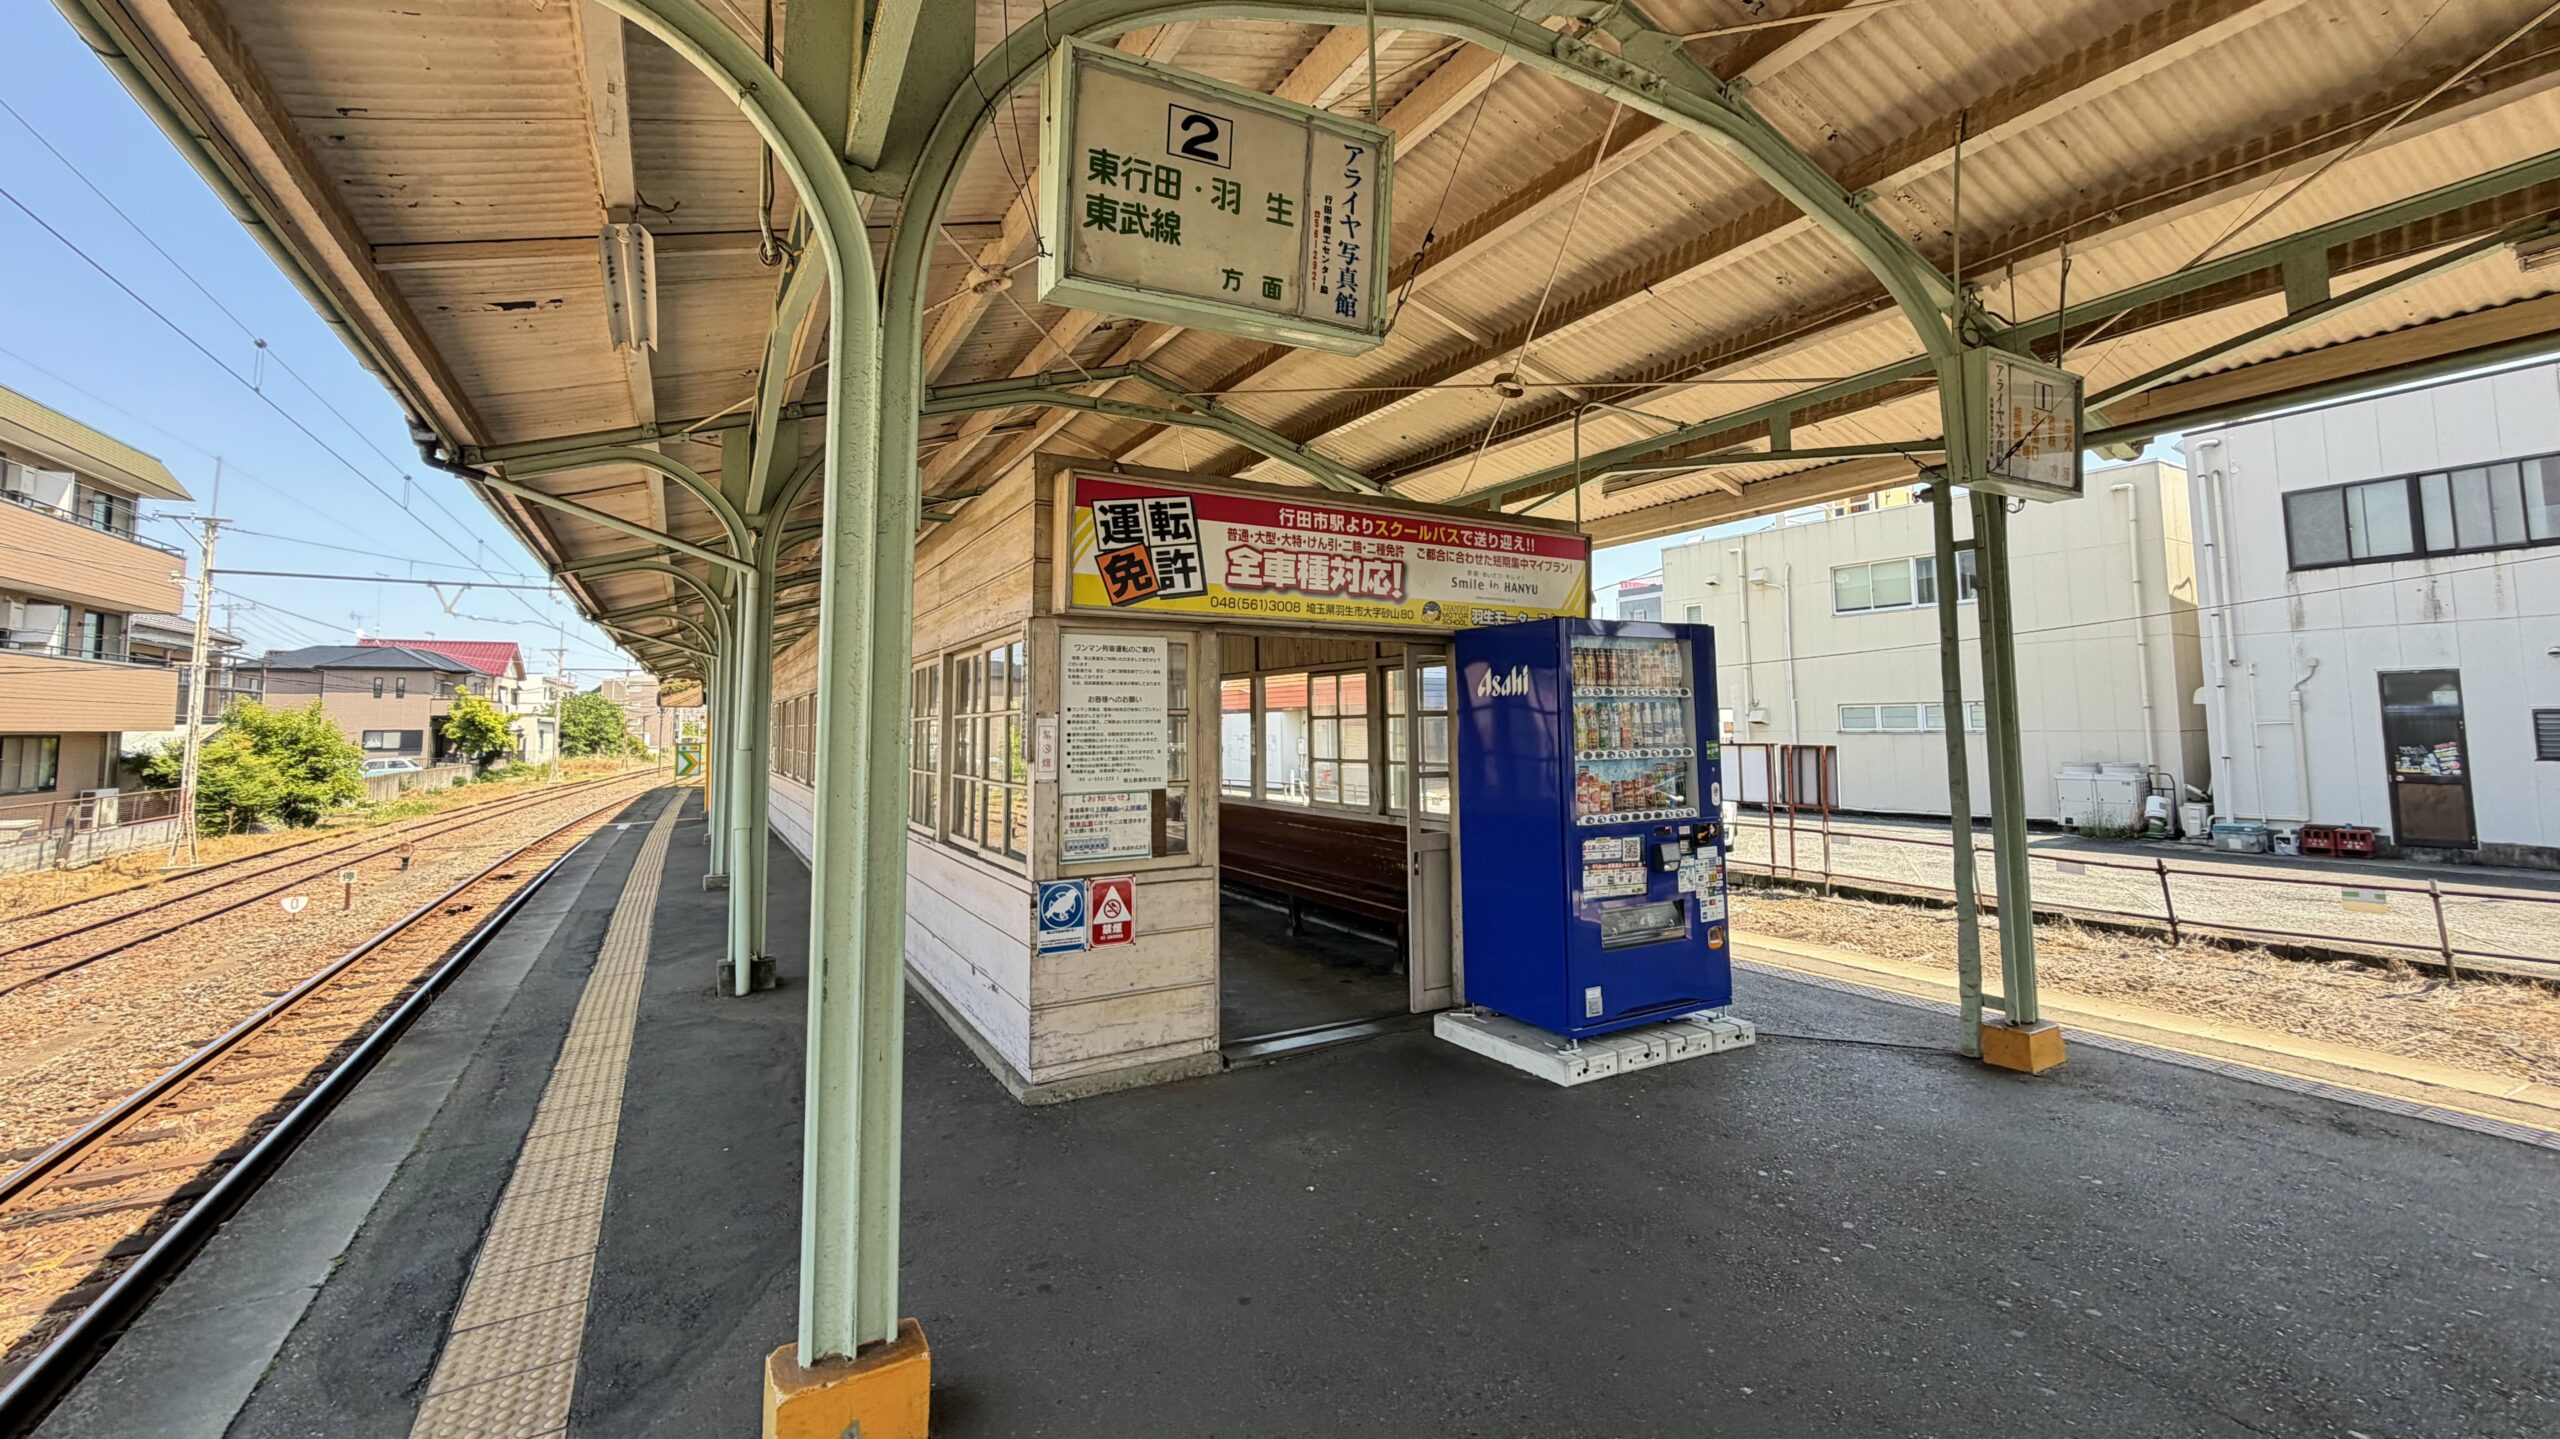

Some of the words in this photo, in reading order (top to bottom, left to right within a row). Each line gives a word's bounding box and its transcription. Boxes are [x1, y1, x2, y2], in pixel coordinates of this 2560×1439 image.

[1180, 114, 1219, 162] 2
[1082, 193, 1182, 246] 東武線
[1334, 144, 1365, 319] アライヤ写真館
[1221, 268, 1284, 301] 方面
[1098, 501, 1192, 545] 運転
[1279, 507, 1535, 552] 行田市駅よりスクールバスで送り迎え!!
[1104, 549, 1197, 598] 免許
[1451, 577, 1484, 590] Smile
[1490, 580, 1499, 589] in
[1504, 582, 1538, 595] HANYU
[1210, 596, 1300, 612] 048(561)3008
[1477, 665, 1529, 697] Asahi
